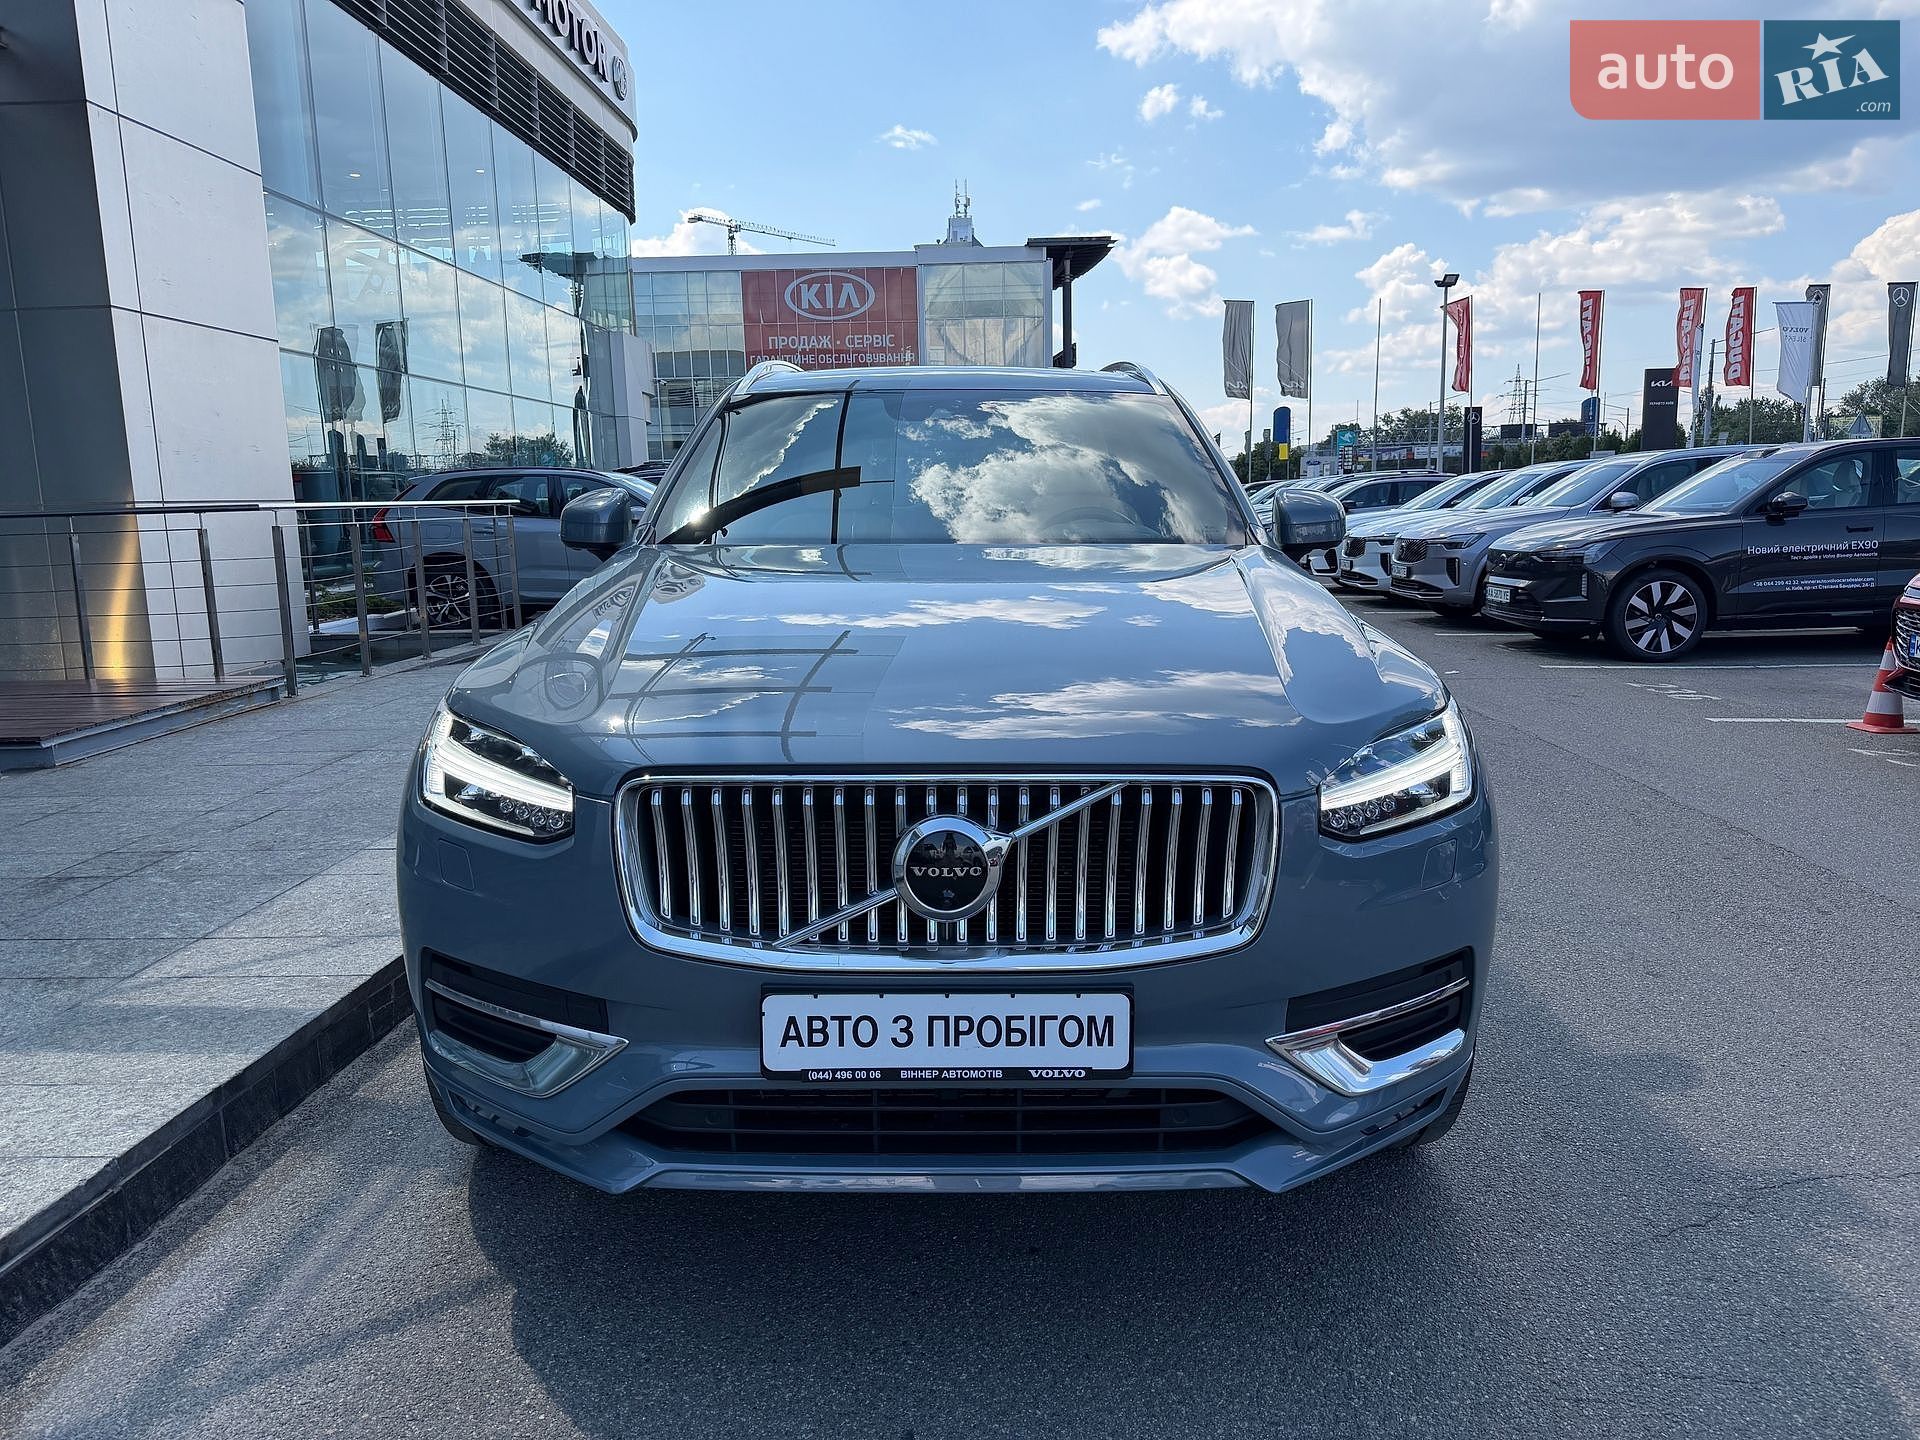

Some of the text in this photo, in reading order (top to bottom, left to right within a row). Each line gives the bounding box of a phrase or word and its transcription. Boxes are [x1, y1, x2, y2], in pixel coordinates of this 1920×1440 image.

[799, 282, 861, 310] KIA
[768, 334, 896, 351] ПРОДАЖ СЕРВІС
[818, 351, 915, 364] ОБСЛУГОВУВАННЯ
[1747, 540, 1879, 555] Новий електричний EX90
[910, 866, 982, 877] VOLVO
[780, 1014, 879, 1048] АВТО
[928, 1014, 1114, 1048] ПРОБІГОМ
[808, 1070, 882, 1081] (044) 496 00 06
[900, 1069, 1003, 1079] ВІННЕР АВТОМОТІВ
[1028, 1069, 1087, 1079] VOLVO
